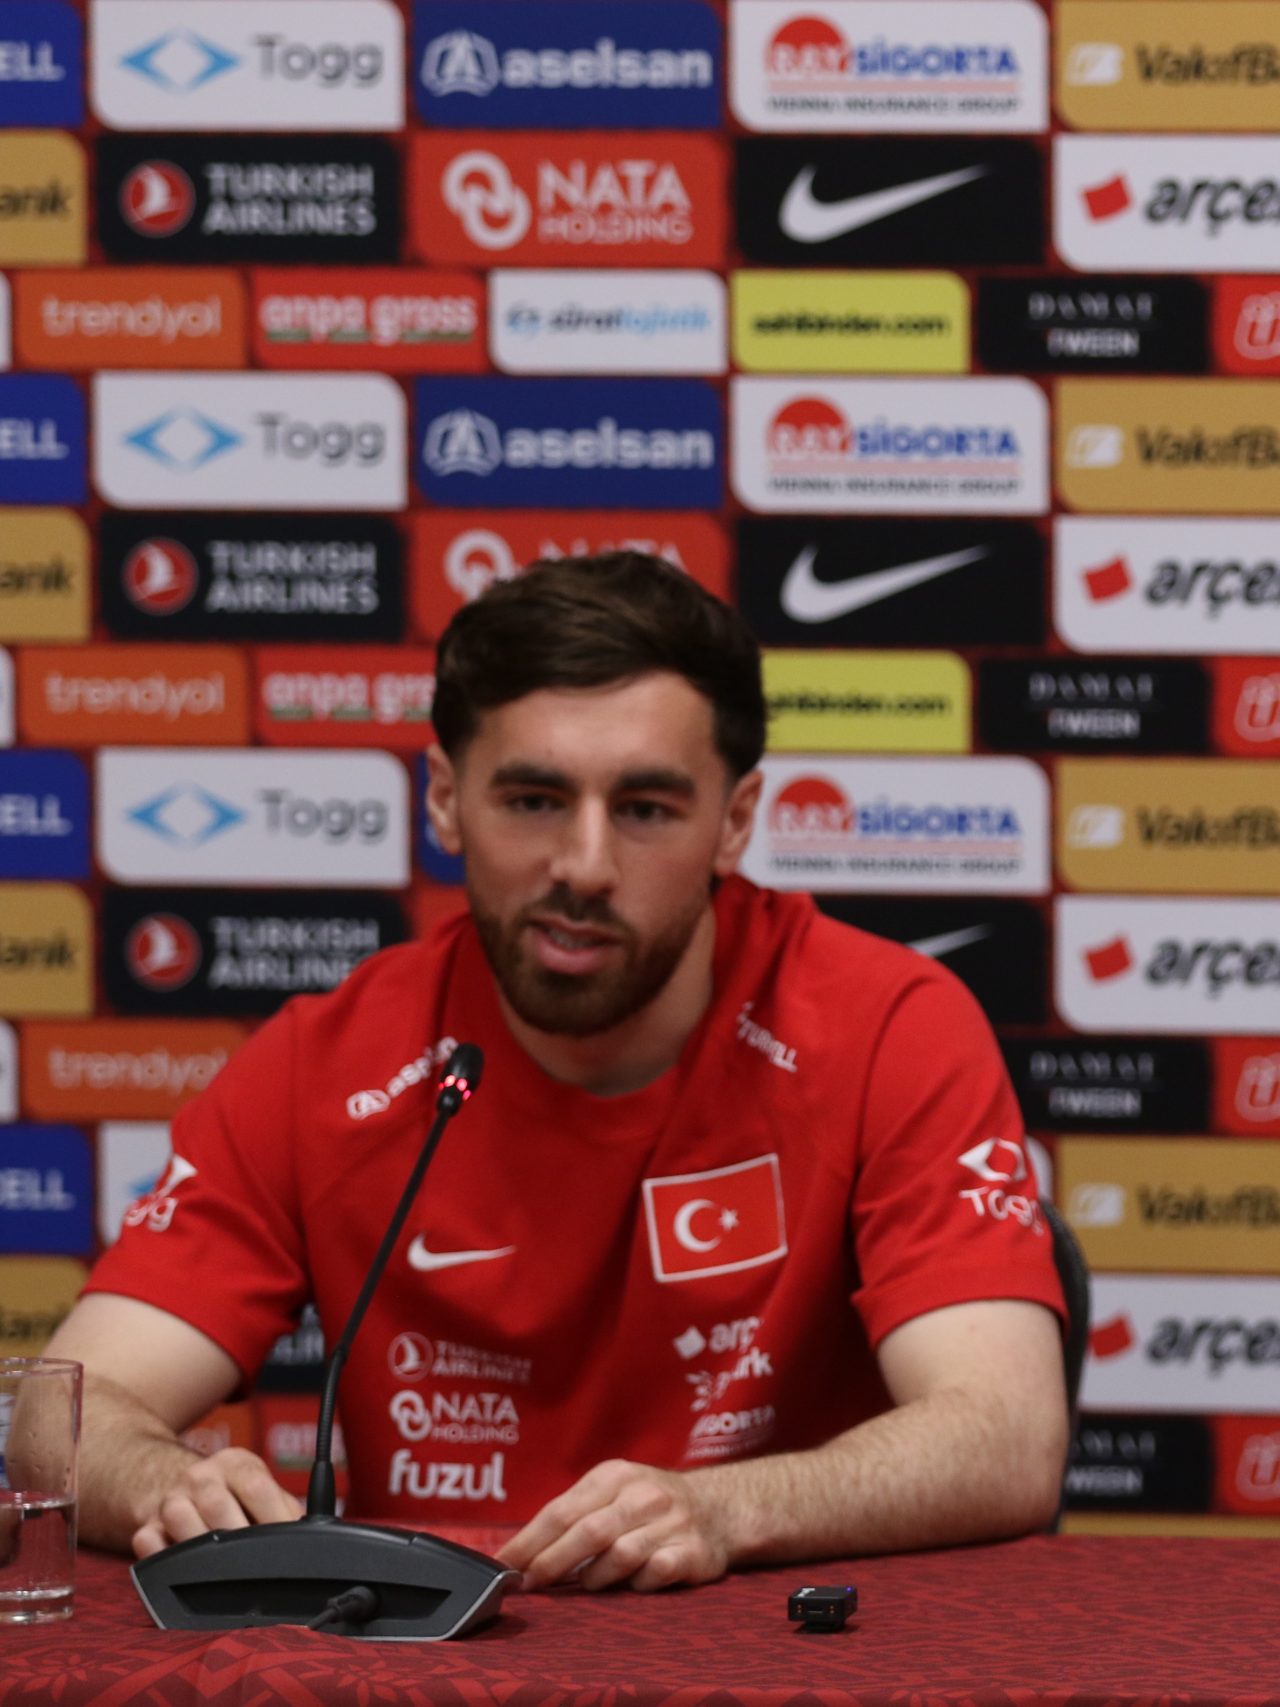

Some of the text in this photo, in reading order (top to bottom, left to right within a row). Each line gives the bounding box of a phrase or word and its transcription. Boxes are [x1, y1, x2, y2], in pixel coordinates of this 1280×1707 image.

[254, 35, 384, 89] Togg
[502, 39, 711, 88] aselsan
[203, 164, 373, 197] TURKISH
[539, 162, 690, 208] NATA
[203, 200, 376, 236] AIRLINES
[539, 211, 692, 244] HOLDING
[43, 297, 221, 342] trendyol
[257, 412, 387, 466] Togg
[503, 418, 714, 468] aselsan
[207, 541, 377, 576] TURKISH
[206, 578, 380, 614] AIRLINES
[45, 672, 225, 722] trendyol
[257, 788, 390, 843] Togg
[209, 916, 380, 951] TURKISH
[207, 952, 363, 990] AIRLINE
[432, 1391, 520, 1425] NATA
[431, 1423, 520, 1446] HOLDING
[388, 1448, 508, 1503] fuzul
